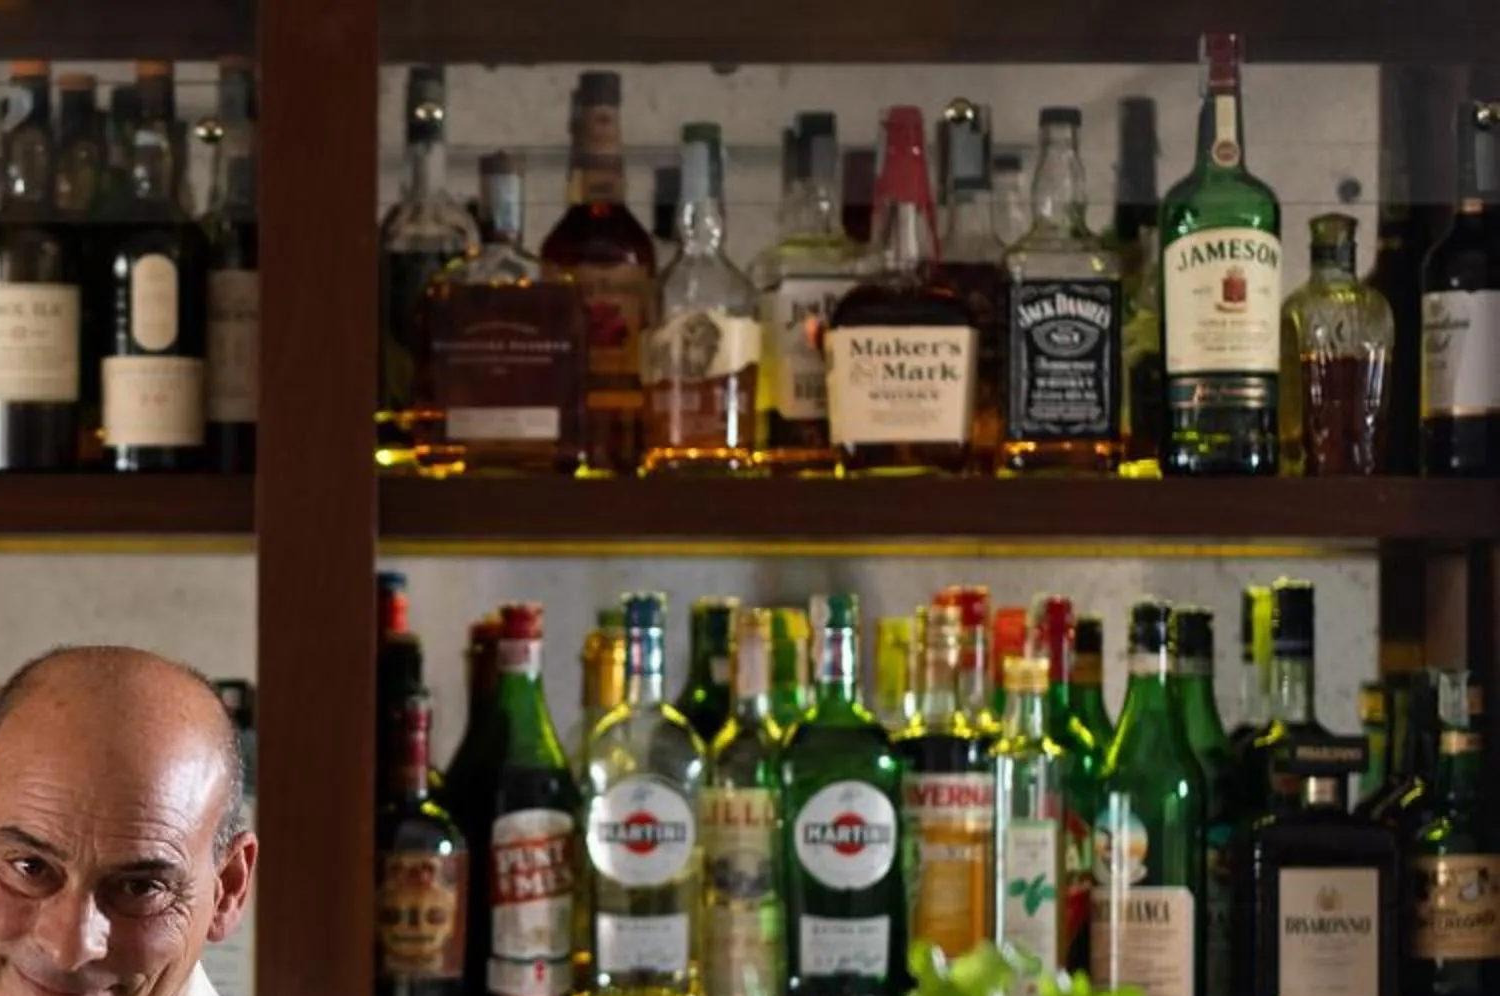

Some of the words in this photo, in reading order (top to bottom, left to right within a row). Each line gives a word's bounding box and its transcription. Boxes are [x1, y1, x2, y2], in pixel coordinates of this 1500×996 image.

[1176, 238, 1279, 273] JAMESON
[1017, 299, 1055, 329] JACK
[850, 337, 962, 357] Maker's
[882, 361, 960, 382] Mark
[1285, 917, 1371, 935] DISARONNO
